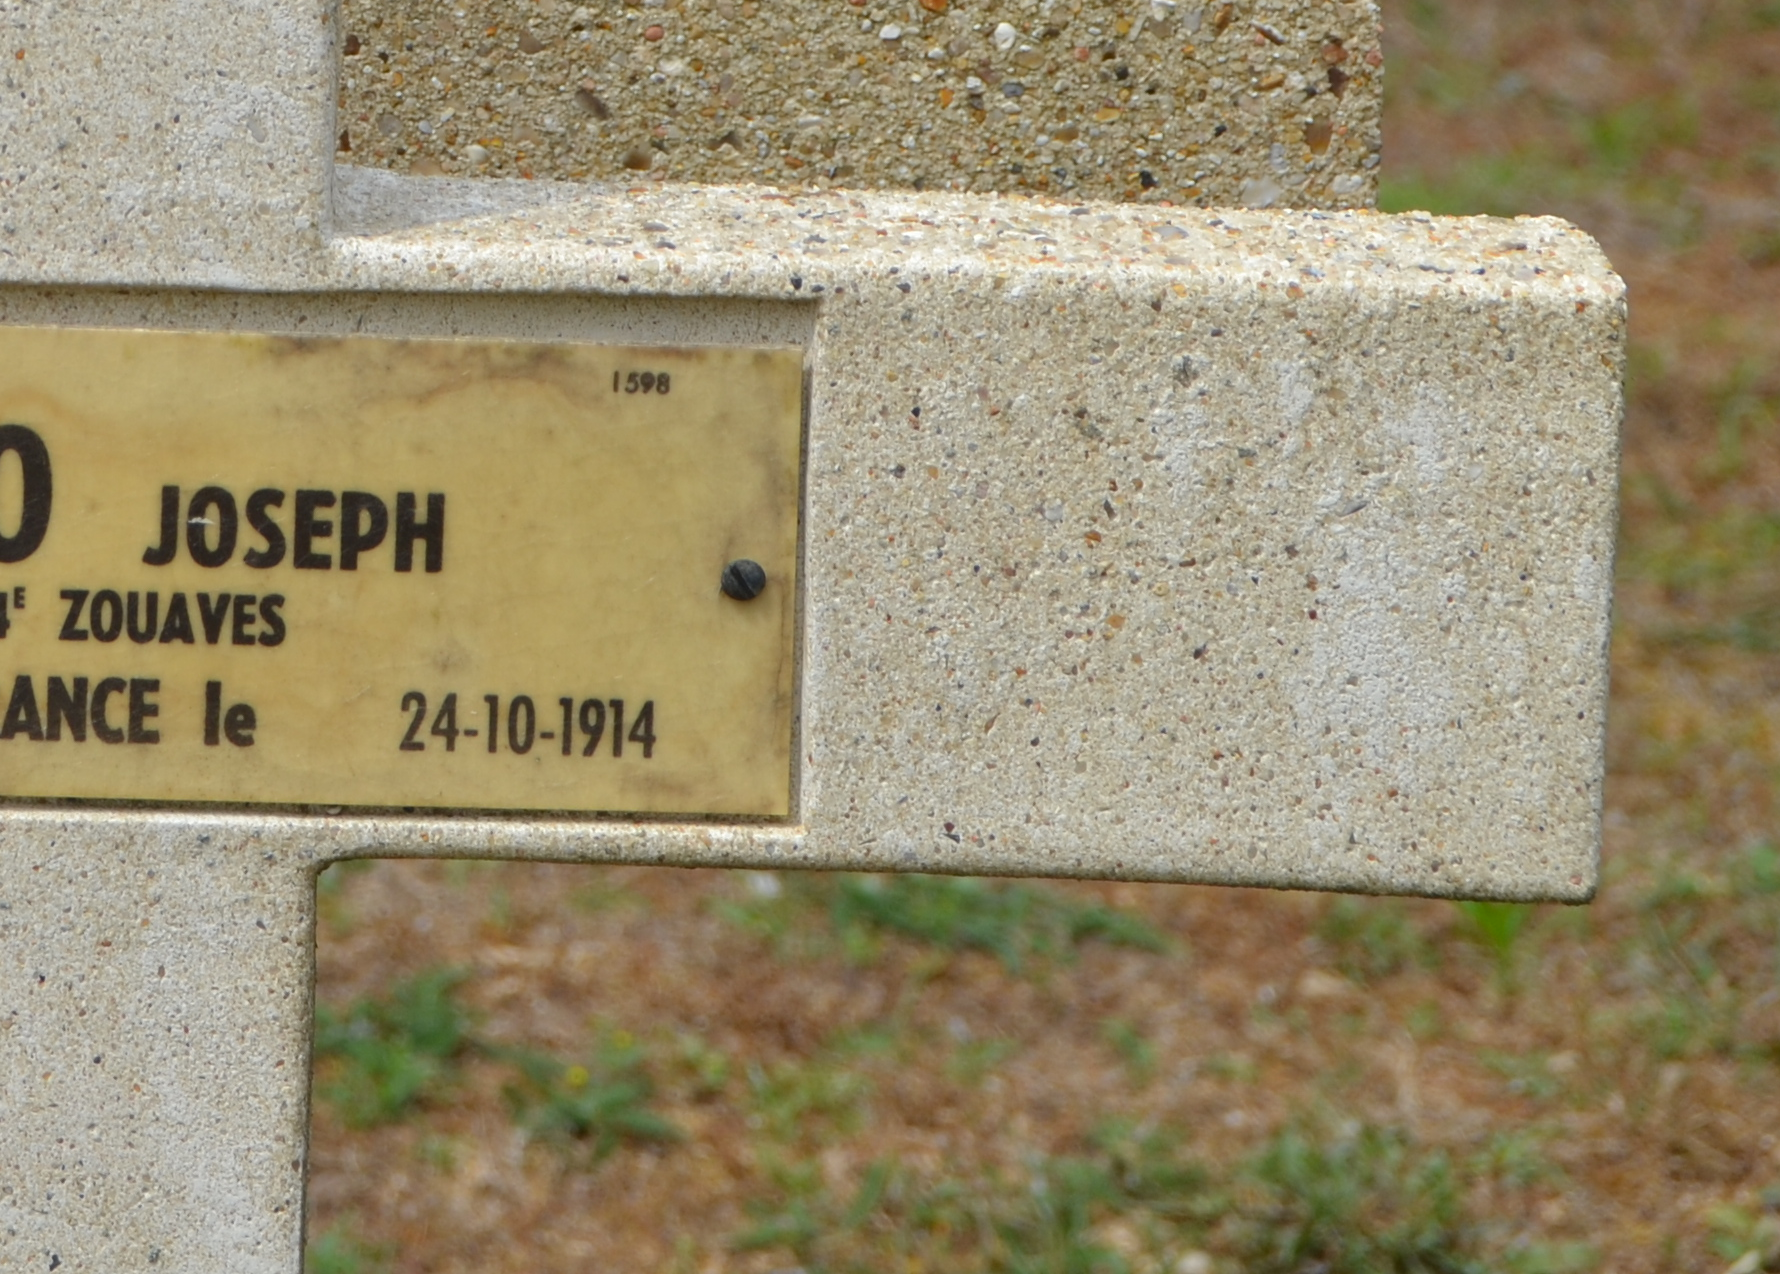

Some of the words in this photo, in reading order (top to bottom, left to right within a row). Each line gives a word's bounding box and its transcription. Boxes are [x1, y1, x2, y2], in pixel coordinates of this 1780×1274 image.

[613, 370, 670, 395] 1598
[141, 485, 446, 574] JOSEPH
[58, 588, 286, 648] ZOUAVES
[203, 680, 257, 748] le
[399, 691, 657, 759] 24-10-1914
